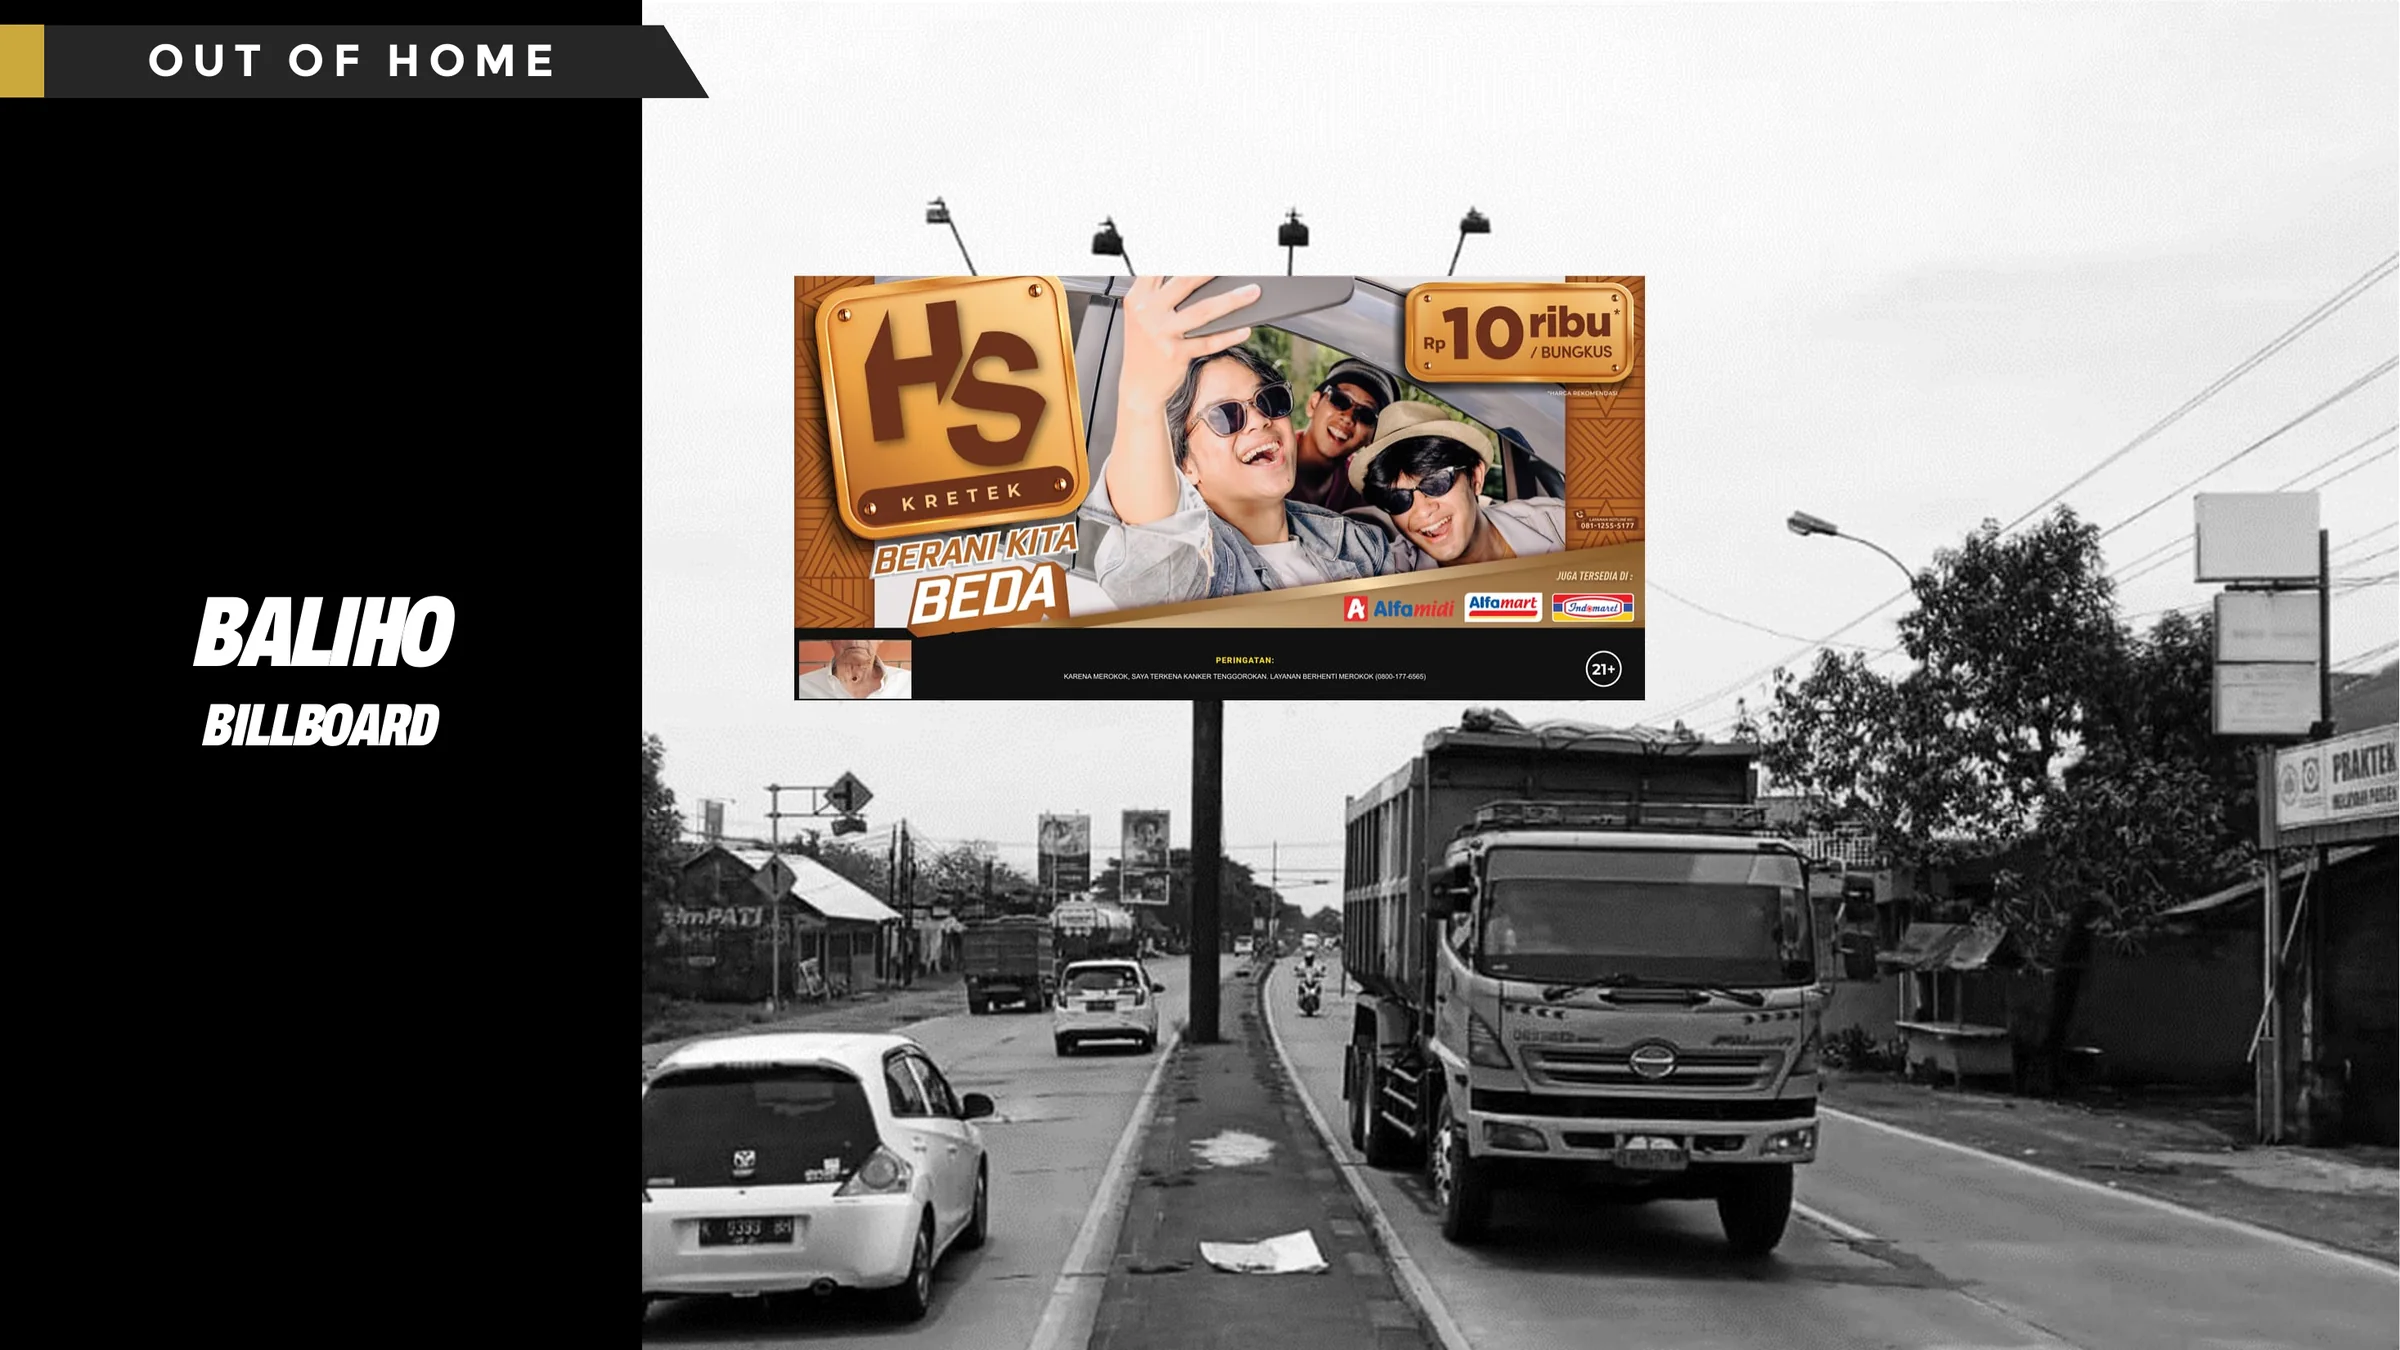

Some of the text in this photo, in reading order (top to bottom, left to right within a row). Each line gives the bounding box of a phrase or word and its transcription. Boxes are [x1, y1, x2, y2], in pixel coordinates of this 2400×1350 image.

[1423, 336, 1446, 353] Rp
[1442, 305, 1525, 361] 10
[1541, 345, 1613, 359] BUNGKUS
[864, 299, 1047, 468] HS
[901, 482, 1022, 511] KRETEK
[1580, 522, 1635, 530] 081-1255-5177
[872, 523, 1080, 576] BERANI KITA
[1556, 570, 1578, 581] JUGA
[1579, 570, 1618, 581] TERSEDIA
[910, 563, 1057, 626] BEDA
[1469, 595, 1538, 609] Alfamart
[1373, 599, 1455, 618] Alfamidi
[1568, 602, 1619, 613] Indomaret
[1215, 656, 1275, 664] PERINGATAN:
[1093, 673, 1131, 681] MEROKOK,
[1375, 672, 1427, 681] (0800-177-6565)
[1591, 662, 1616, 677] 21+
[2332, 741, 2397, 785] PRAKTEK
